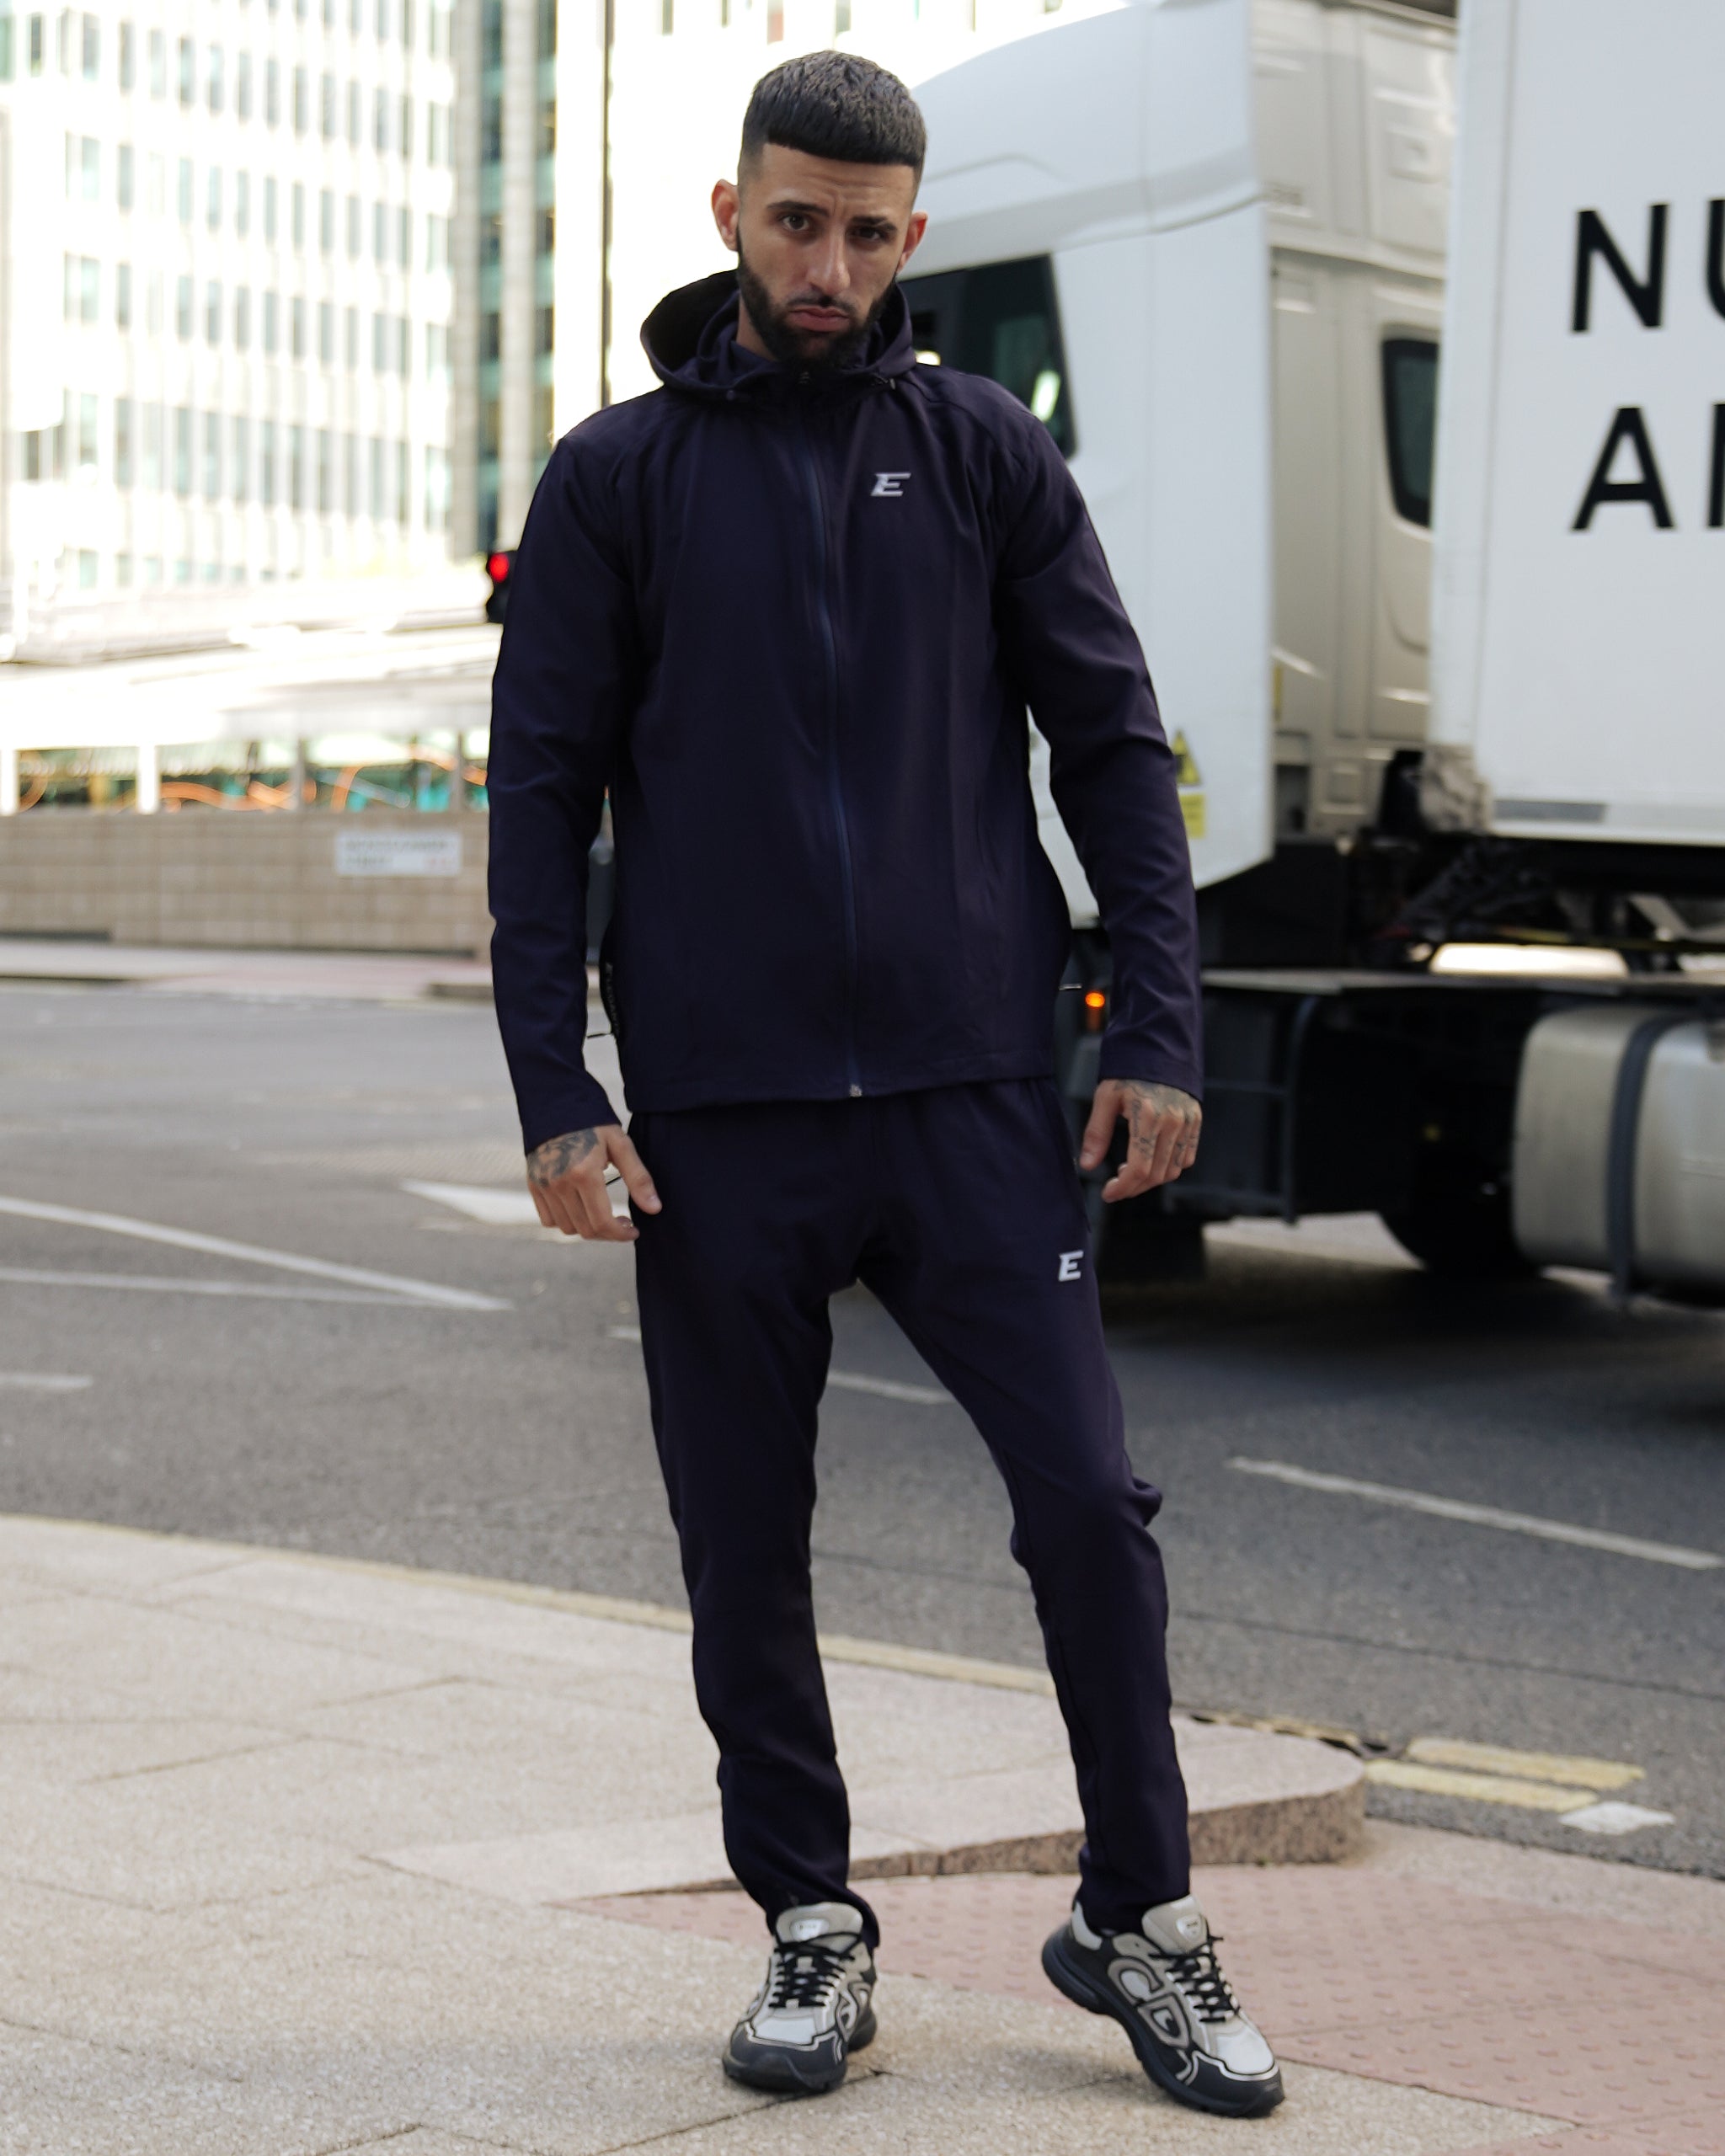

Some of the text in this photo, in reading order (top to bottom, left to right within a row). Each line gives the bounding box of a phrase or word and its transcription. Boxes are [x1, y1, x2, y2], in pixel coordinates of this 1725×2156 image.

[1572, 199, 1725, 334] N
[871, 472, 911, 497] E
[1572, 403, 1725, 531] A
[1059, 1250, 1084, 1282] E
